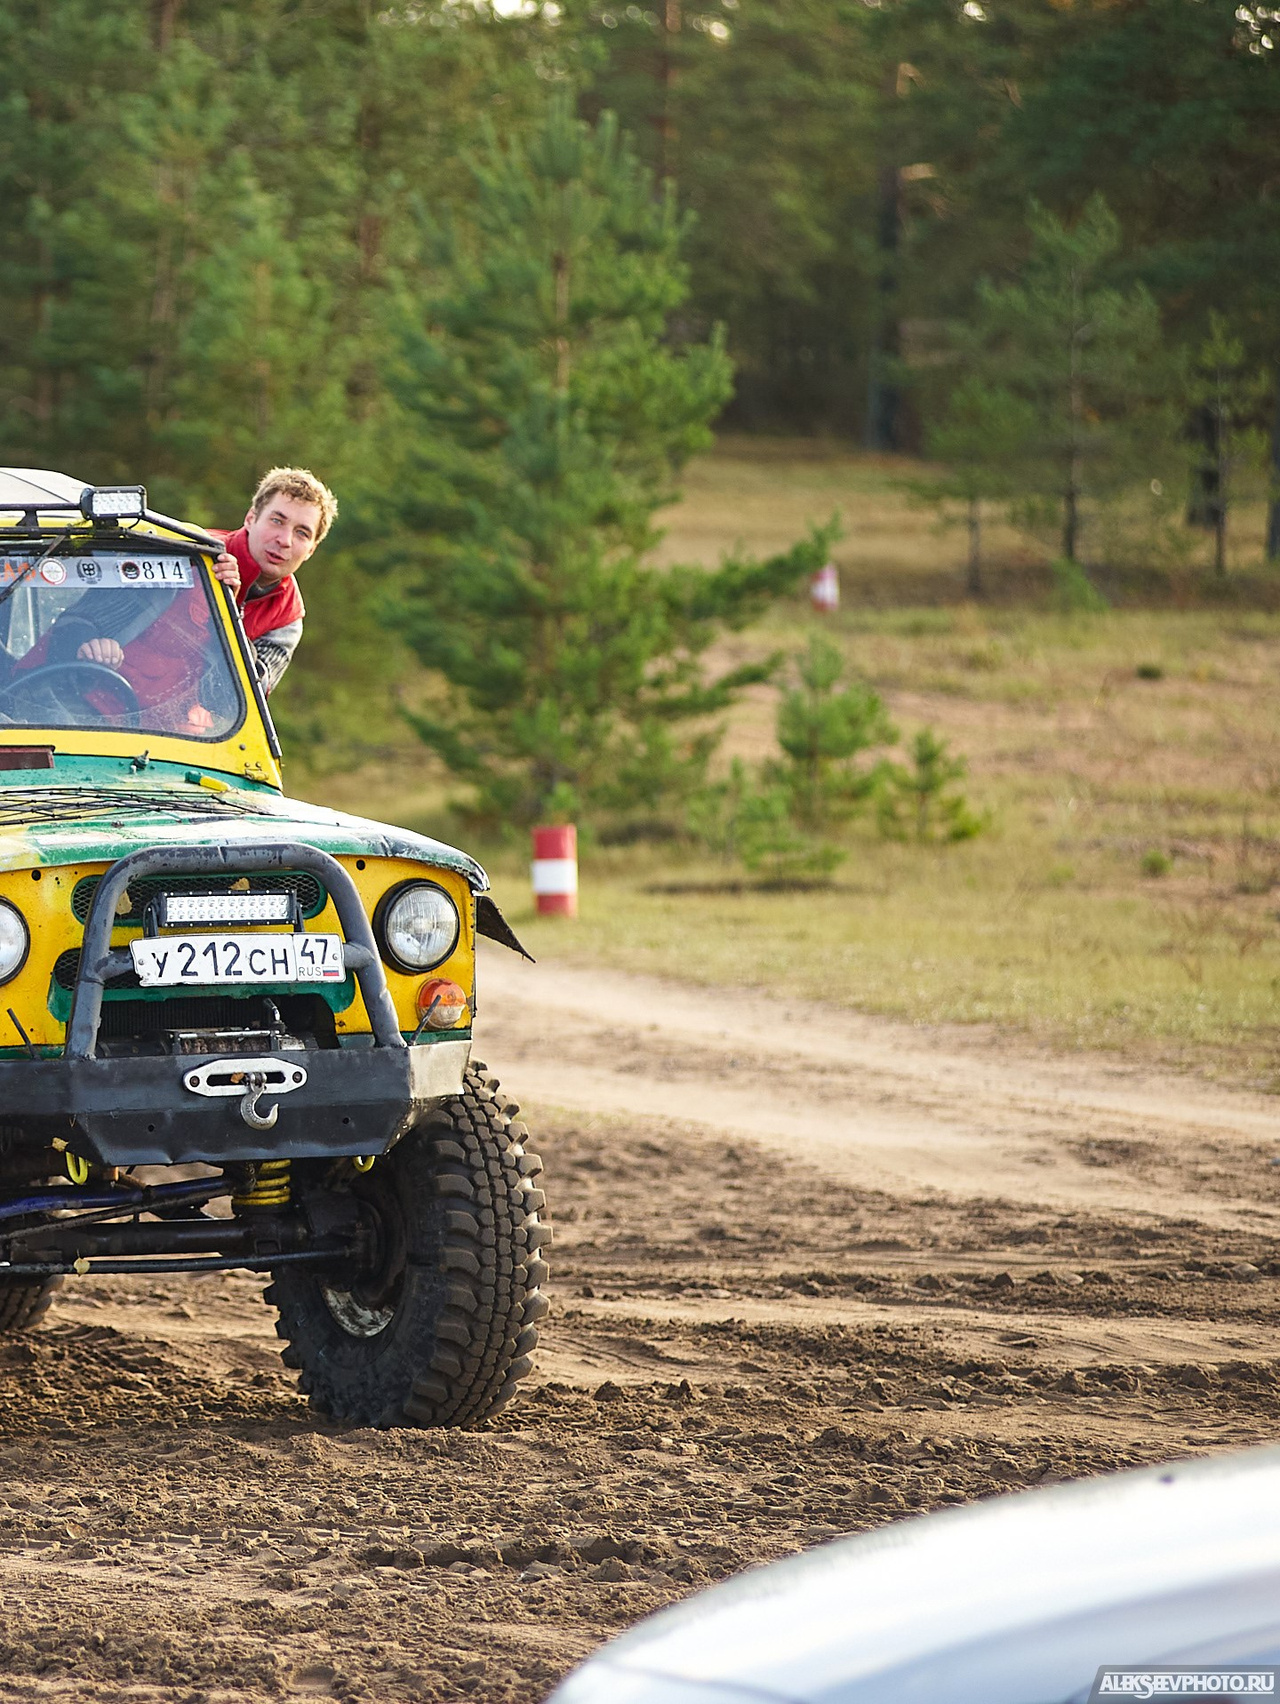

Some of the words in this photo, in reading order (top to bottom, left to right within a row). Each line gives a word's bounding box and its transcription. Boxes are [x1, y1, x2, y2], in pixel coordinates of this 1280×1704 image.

[142, 561, 183, 580] 814
[300, 938, 328, 965] 47
[298, 966, 322, 977] RUS
